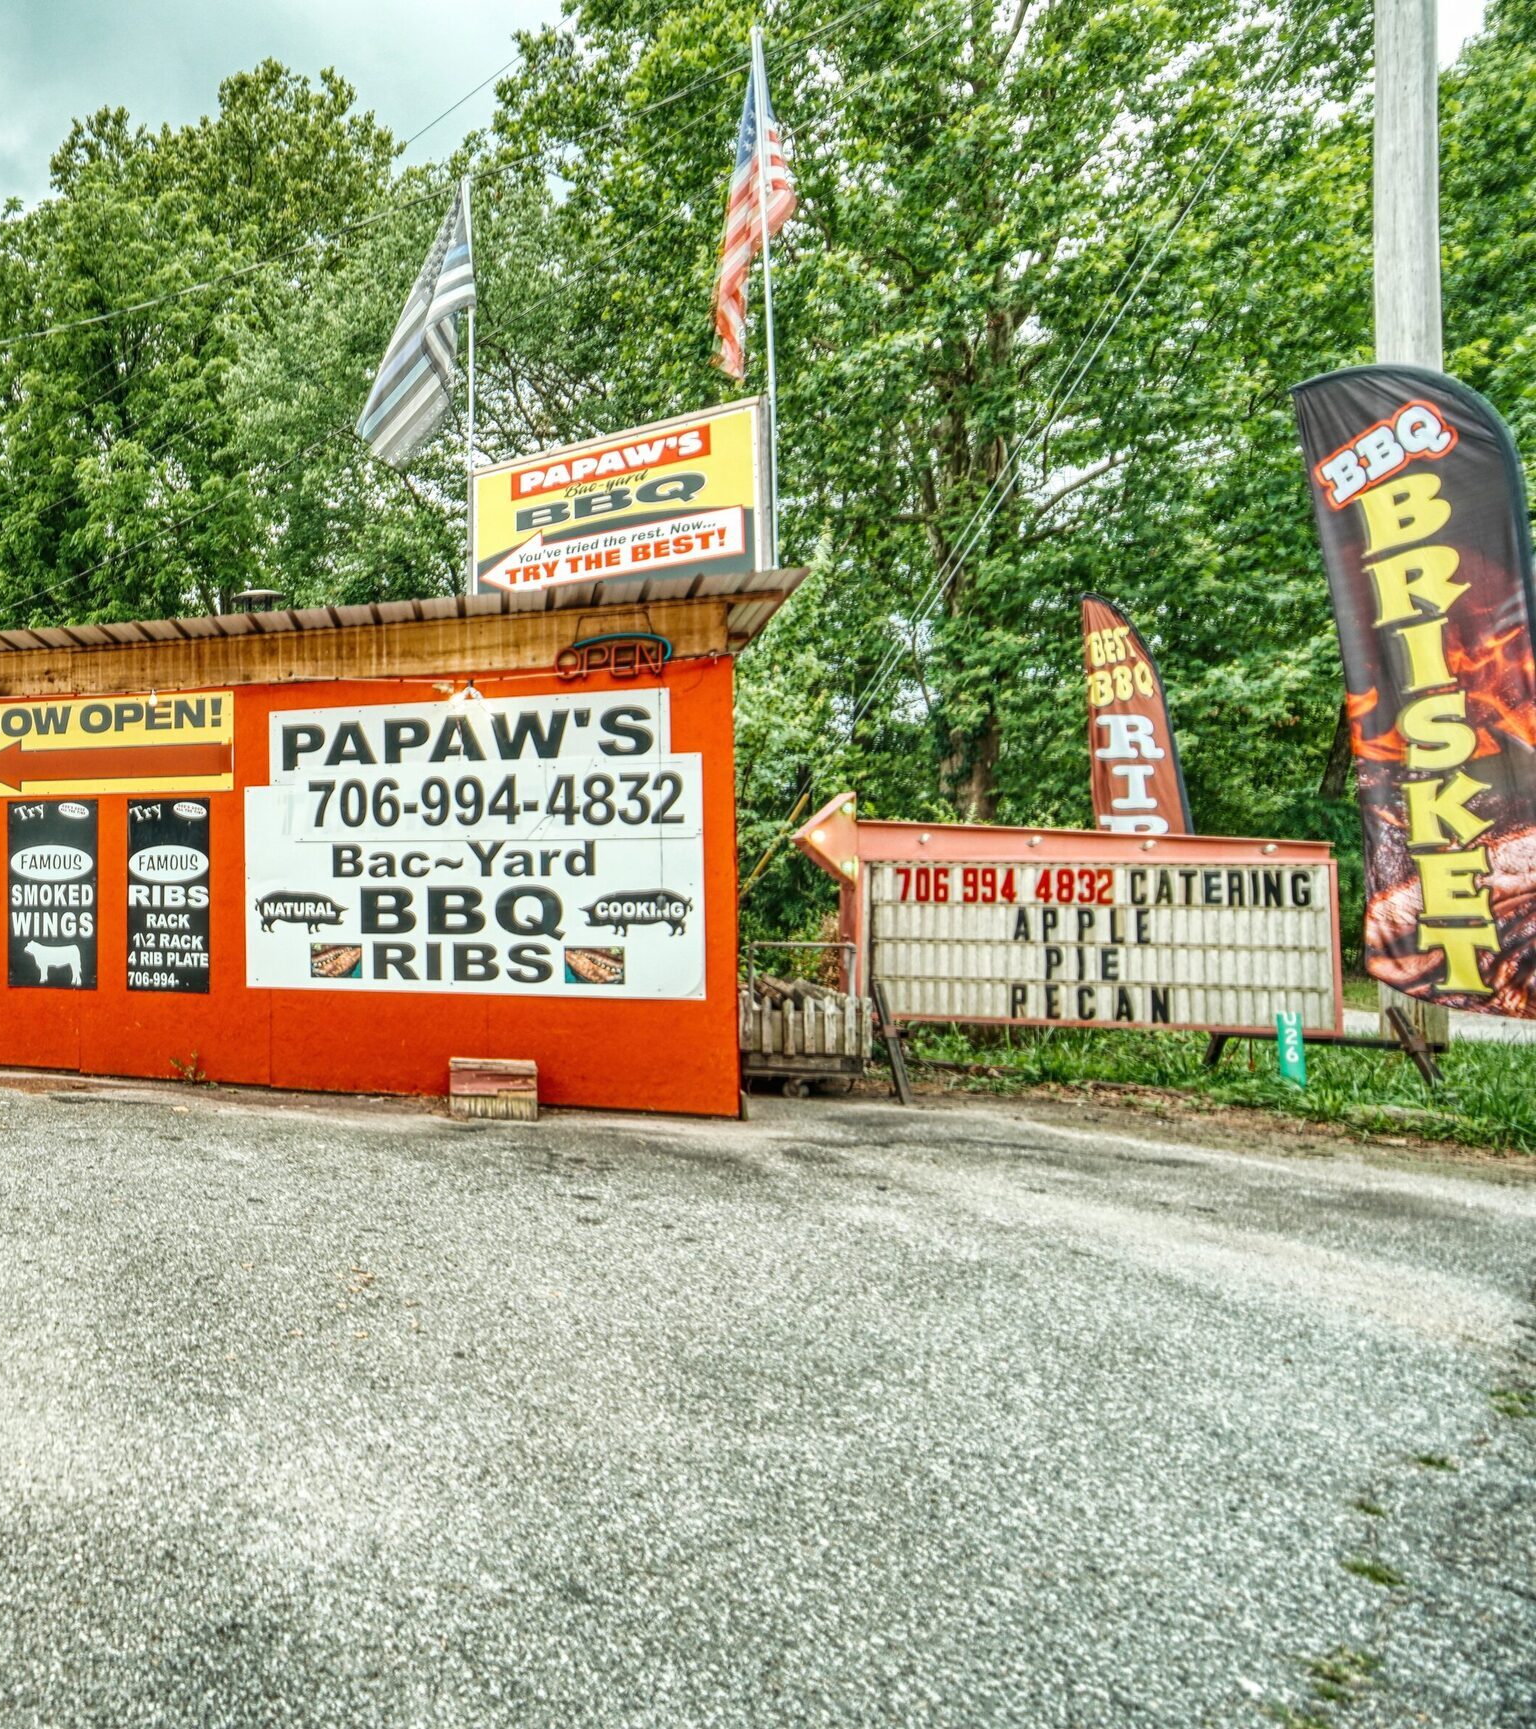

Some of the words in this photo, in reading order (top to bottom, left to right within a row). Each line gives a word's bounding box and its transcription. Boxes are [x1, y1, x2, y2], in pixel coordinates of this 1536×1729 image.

[520, 431, 703, 494] PAPAW'S
[1320, 405, 1452, 504] BBQ
[516, 472, 706, 532] BBQ
[505, 558, 562, 585] TRY
[565, 550, 621, 574] THE
[631, 527, 727, 563] BEST!
[518, 549, 561, 564] You've
[566, 540, 599, 557] tried
[603, 535, 626, 550] the
[554, 640, 664, 680] OPEN
[1087, 626, 1136, 667] BEST
[1087, 660, 1154, 707] BBQ
[79, 697, 222, 733] OPEN!
[281, 705, 654, 771] PAPAW'S
[1360, 472, 1501, 996] BRISKET
[14, 803, 45, 821] Try
[129, 803, 162, 822] Try
[307, 768, 686, 829] 706-994-4832
[21, 853, 82, 871] FAMOUS
[139, 853, 199, 872] FAMOUS
[331, 840, 596, 879] Bac~Yard
[11, 884, 94, 907] SMOKED
[128, 884, 210, 909] RIBS
[896, 867, 949, 903] 706
[963, 867, 1016, 903] 994
[1035, 868, 1114, 905] 4832
[1130, 869, 1311, 908] CATERING
[11, 911, 94, 938] WINGS
[146, 913, 191, 929] RACK
[262, 900, 337, 919] NATURAL
[359, 883, 566, 942] BBQ
[595, 900, 686, 920] COOKING
[1014, 907, 1151, 944] APPLE
[128, 950, 137, 967] 4
[140, 951, 163, 967] RIB
[166, 952, 209, 968] PLATE
[159, 933, 204, 951] RACK
[128, 971, 180, 988] 706-994-
[371, 941, 555, 985] RIBS
[1045, 945, 1119, 981] PIE
[1012, 983, 1170, 1024] PECAN
